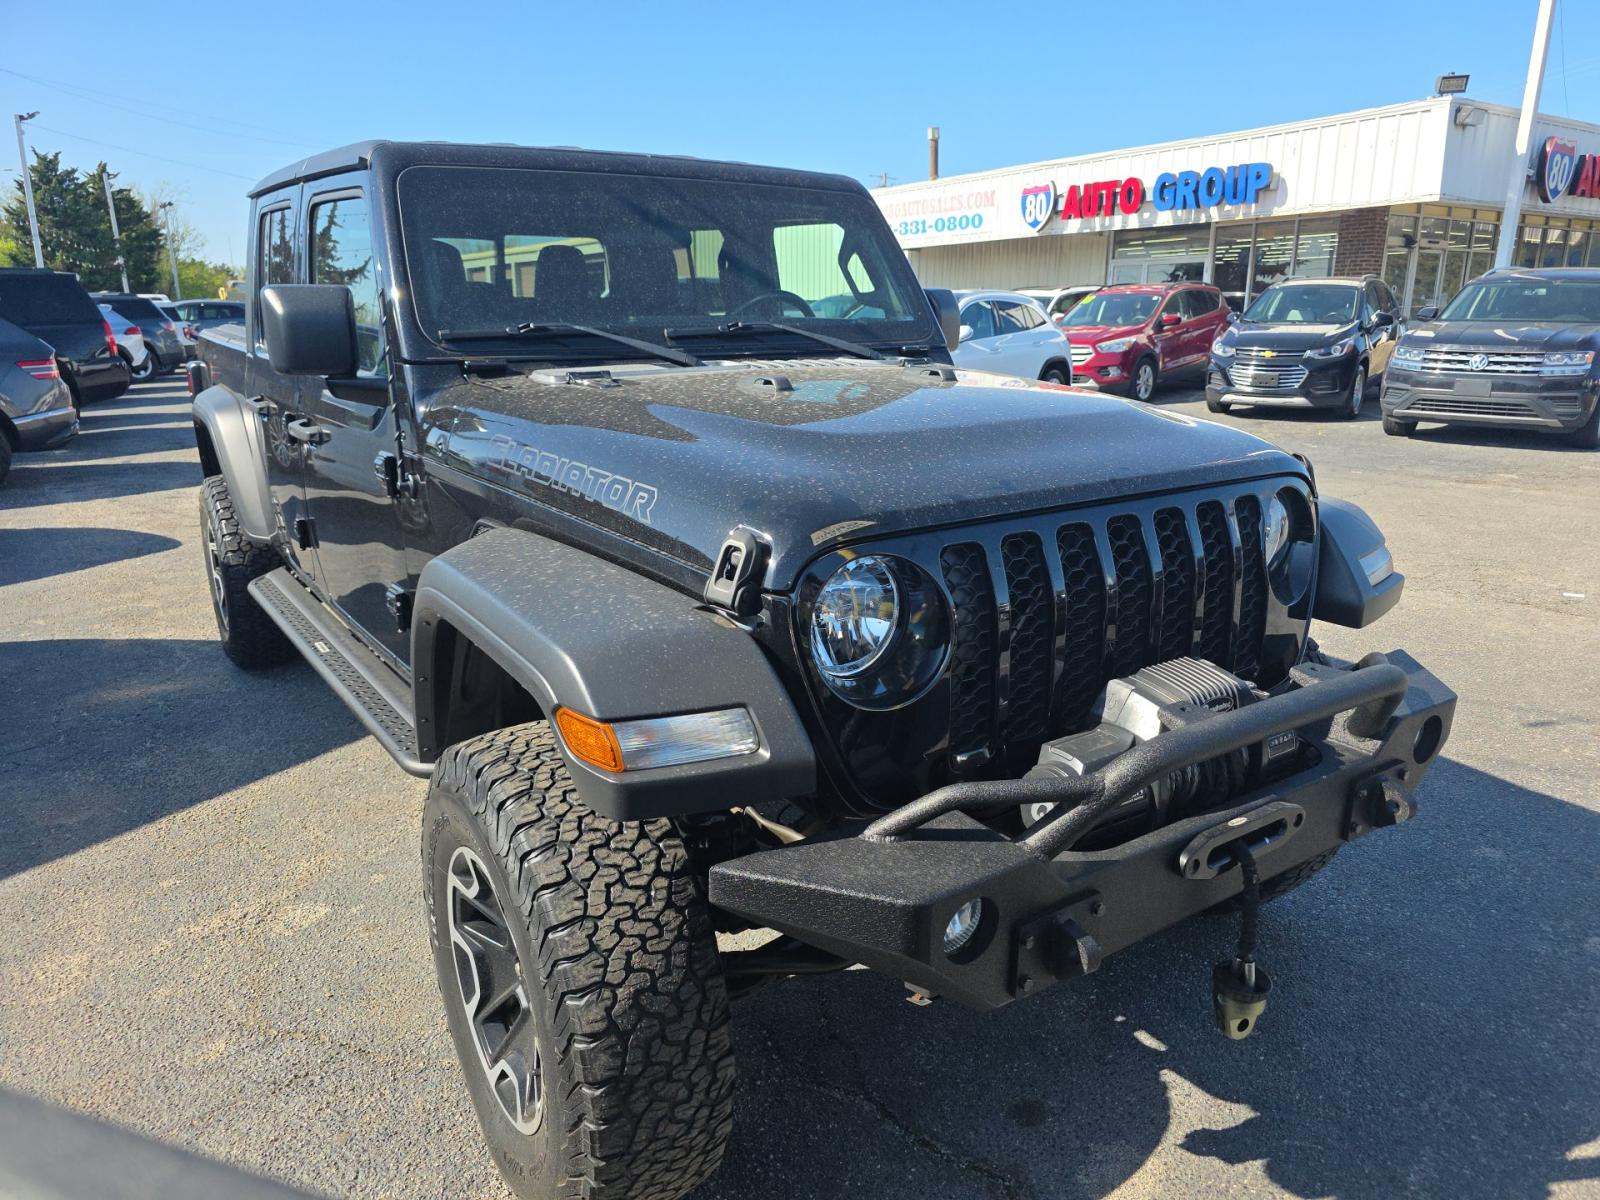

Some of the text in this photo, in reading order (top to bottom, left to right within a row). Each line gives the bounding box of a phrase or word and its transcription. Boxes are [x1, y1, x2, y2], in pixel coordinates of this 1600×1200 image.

[1025, 163, 1273, 224] 80 AUTO GROUP
[1549, 153, 1570, 191] 80
[487, 434, 658, 525] GLADIATOR
